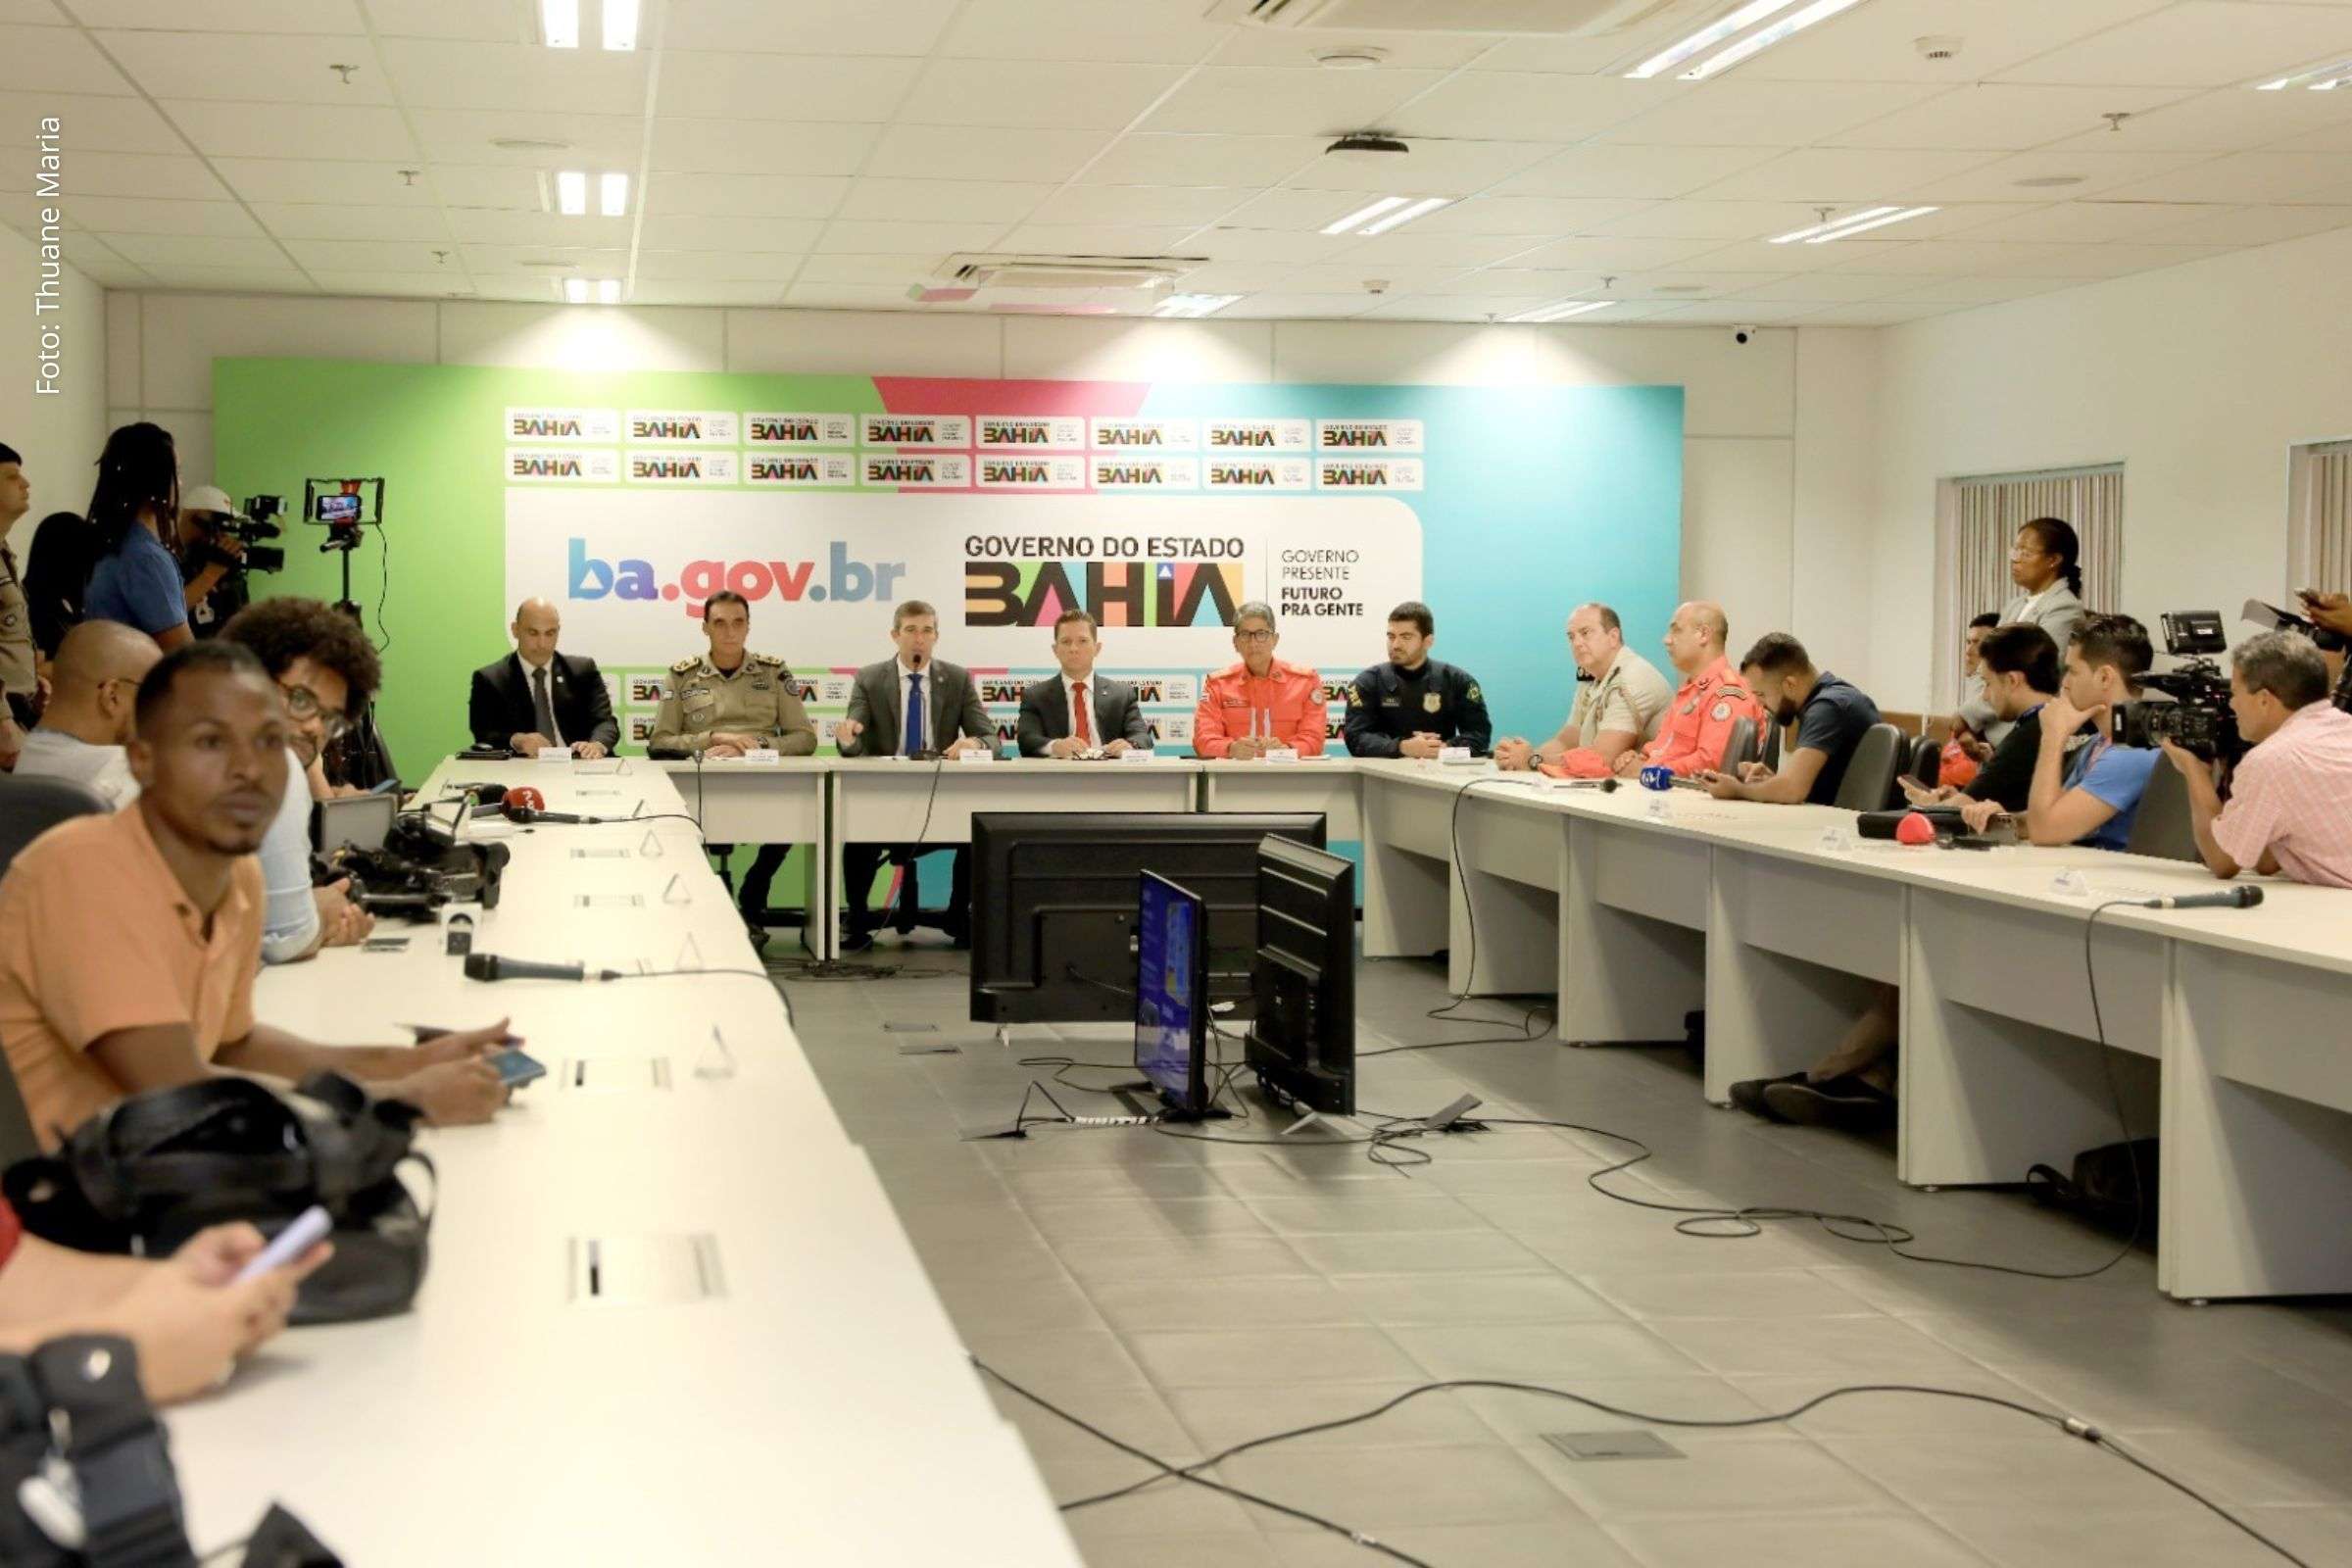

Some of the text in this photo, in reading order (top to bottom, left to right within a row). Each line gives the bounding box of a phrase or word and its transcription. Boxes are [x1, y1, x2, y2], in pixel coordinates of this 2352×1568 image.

[514, 418, 581, 436] BAHIA
[633, 421, 701, 439] BAHIA
[752, 423, 818, 440] BAHIA
[868, 425, 934, 442] BAHIA
[984, 427, 1049, 443] BAHIA
[1098, 429, 1162, 445] BAHIA
[1211, 430, 1275, 446] BAHIA
[1323, 430, 1388, 447] BAHIA
[514, 460, 582, 476] BAHIA
[633, 462, 701, 478] BAHIA
[752, 464, 818, 479] BAHIA
[868, 466, 934, 481] BAHIA
[984, 466, 1049, 482] BAHIA
[1098, 468, 1162, 483] BAHIA
[1211, 468, 1275, 484] BAHIA
[1323, 469, 1387, 485] BAHIA
[964, 535, 1245, 559] GOVERNO DO ESTADO
[1281, 549, 1360, 564] GOVERNO
[568, 537, 906, 618] ba.gov.br
[1282, 565, 1349, 581] PRESENTE
[964, 562, 1244, 627] BAHIA
[1281, 587, 1344, 601] FUTURO
[1281, 603, 1364, 616] PRA GENTE
